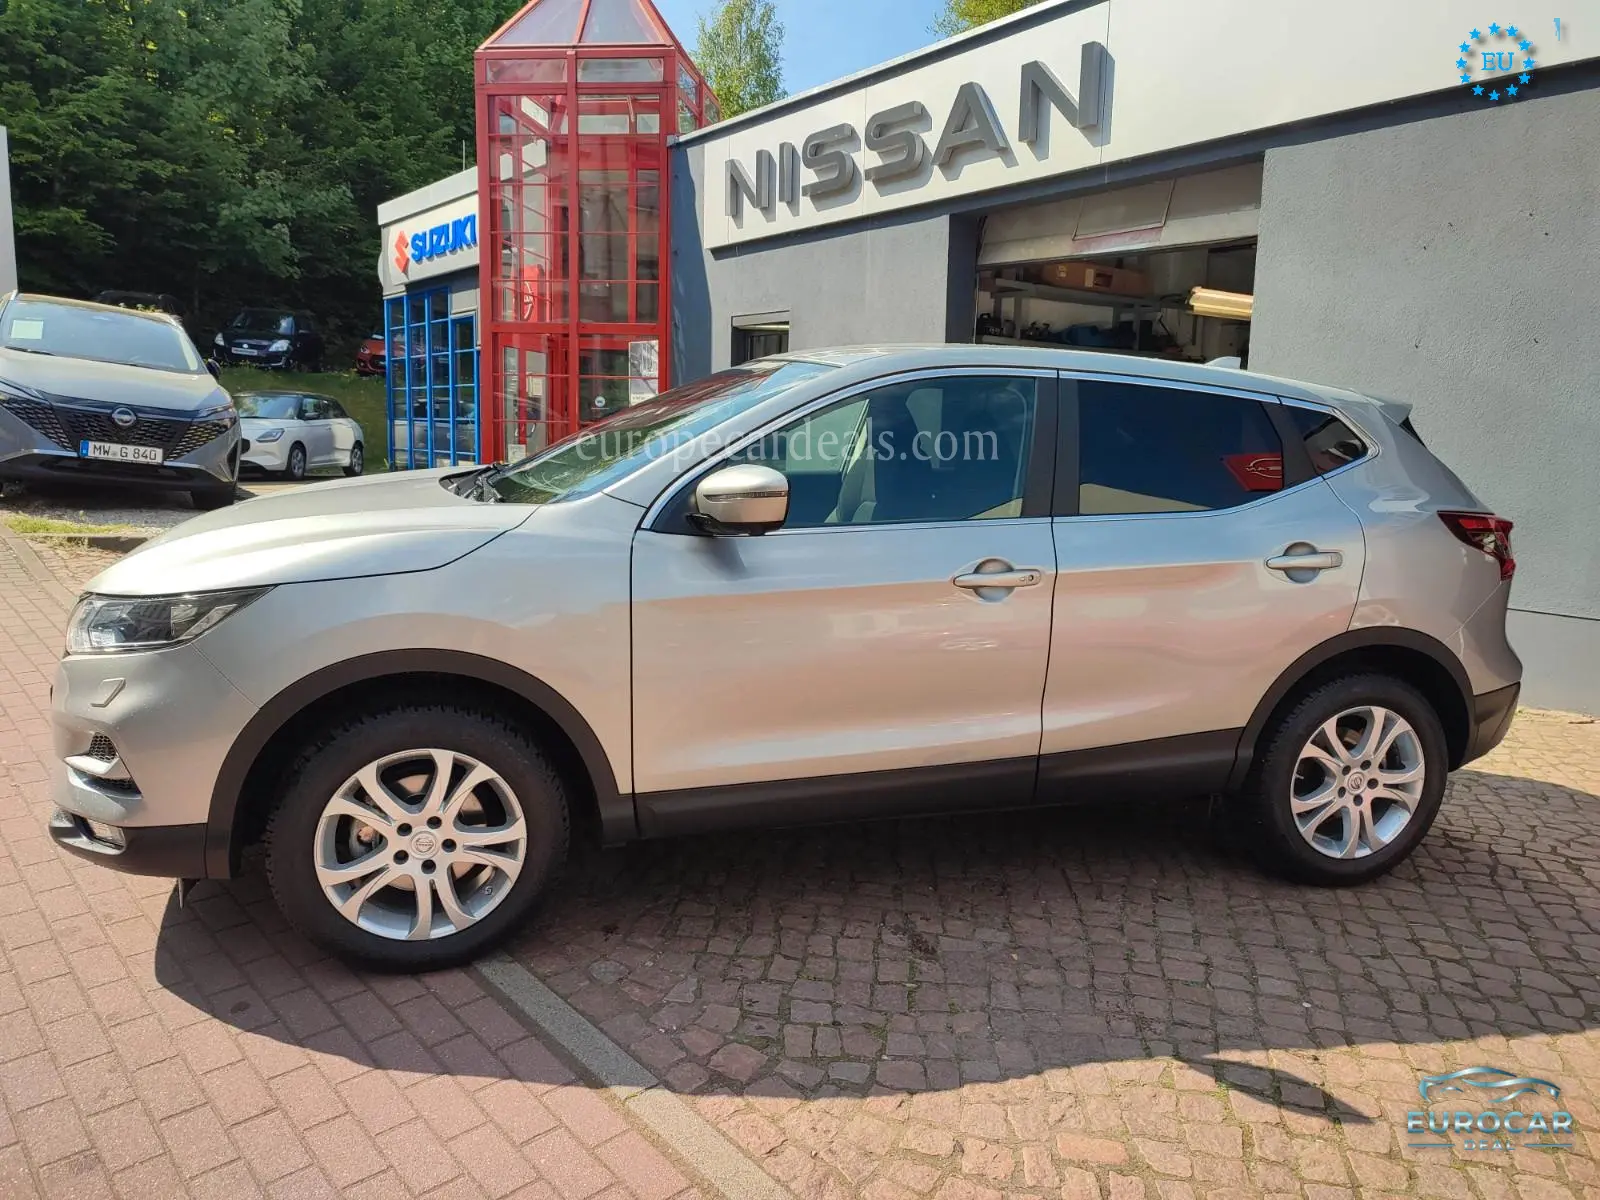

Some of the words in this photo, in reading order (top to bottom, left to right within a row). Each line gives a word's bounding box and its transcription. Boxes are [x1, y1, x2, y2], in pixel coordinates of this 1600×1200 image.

[725, 40, 1110, 217] NISSAN
[411, 213, 478, 262] SUZUKI
[93, 444, 111, 457] MW
[132, 448, 157, 461] 840
